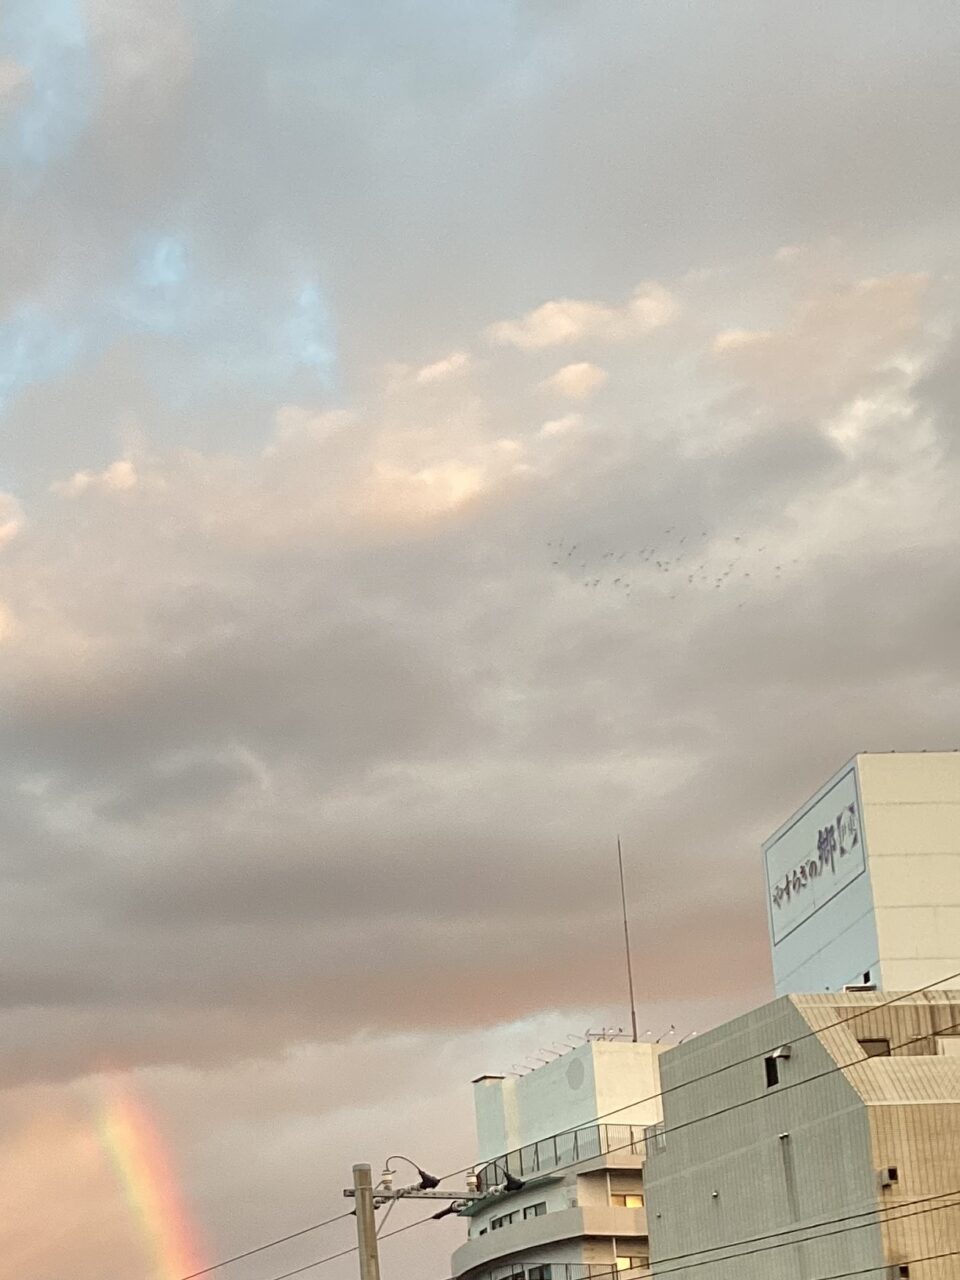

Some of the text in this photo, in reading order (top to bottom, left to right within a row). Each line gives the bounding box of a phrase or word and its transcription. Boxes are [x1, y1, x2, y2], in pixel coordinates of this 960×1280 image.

[772, 824, 836, 909] やすらぎの郷
